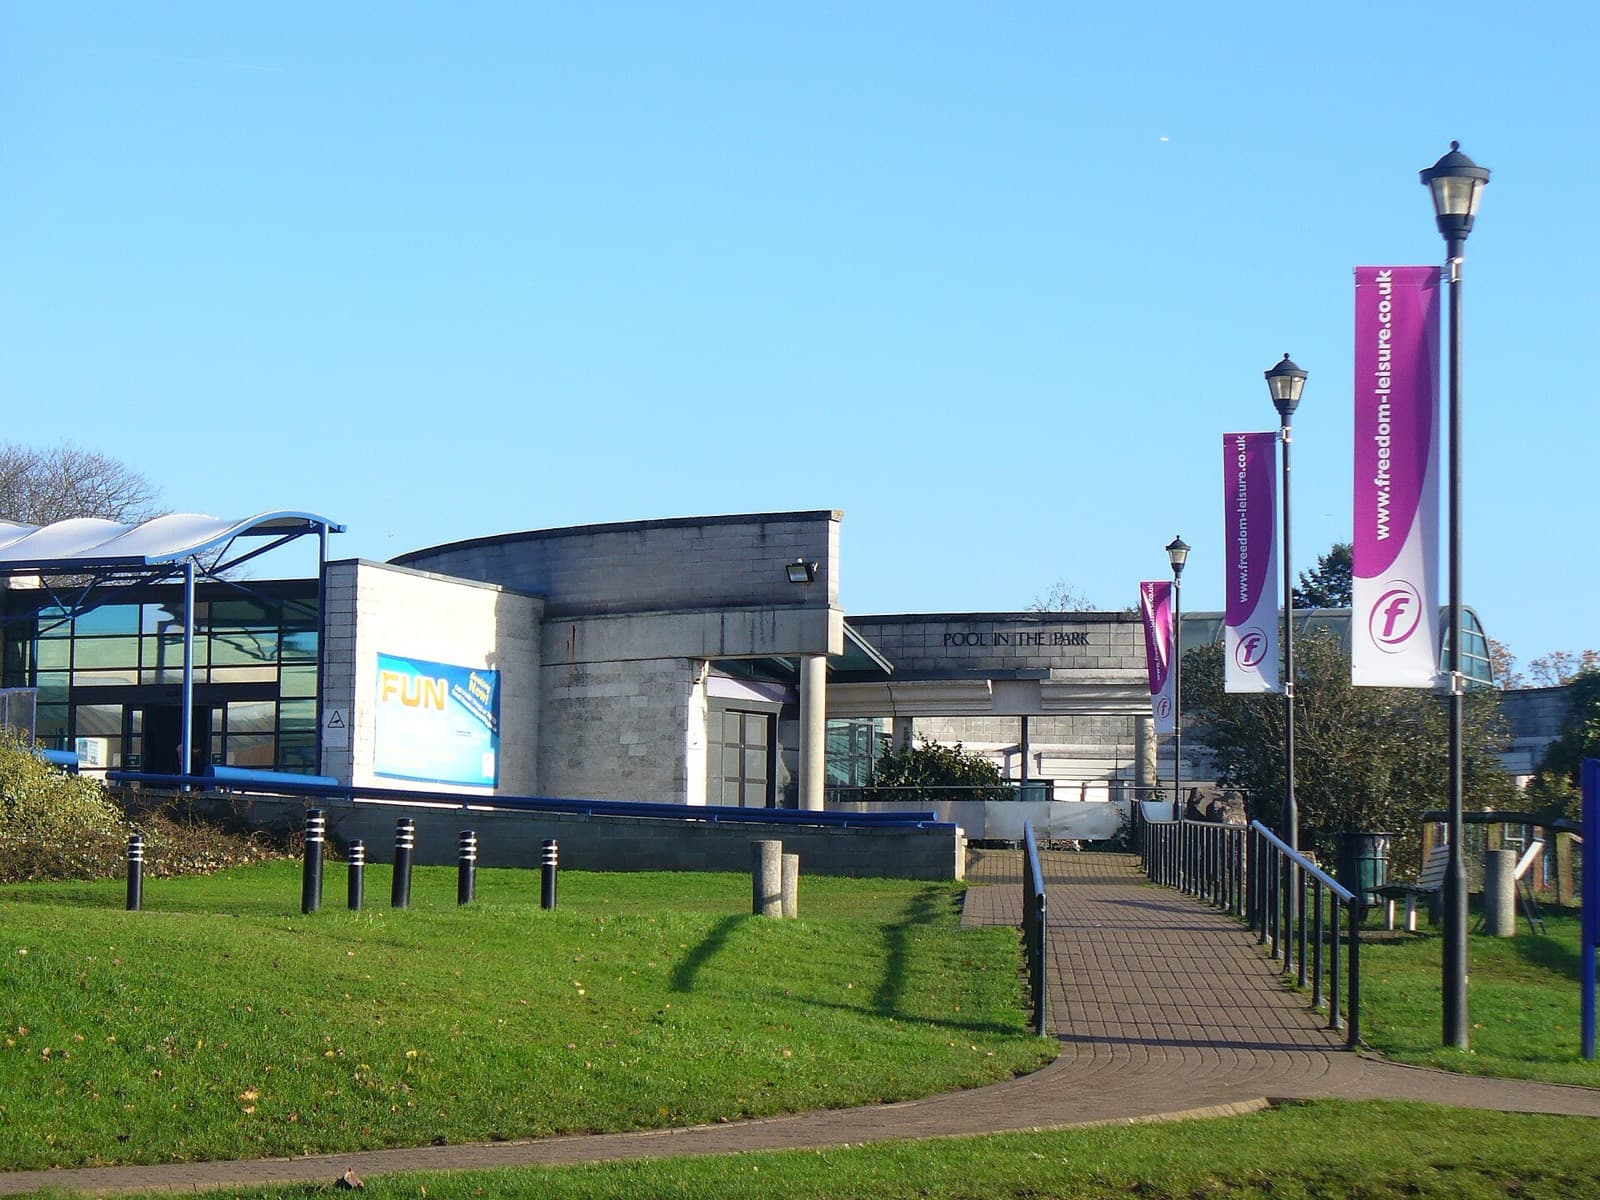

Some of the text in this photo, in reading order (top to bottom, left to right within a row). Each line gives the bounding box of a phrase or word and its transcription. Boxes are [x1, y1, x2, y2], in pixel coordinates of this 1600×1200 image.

[1374, 269, 1393, 542] www.freedom-leisure.co.uk
[1237, 434, 1247, 604] www.freedom-leisure.co.uk
[381, 670, 445, 711] FUN
[943, 631, 1091, 647] POOL IN THE PARK
